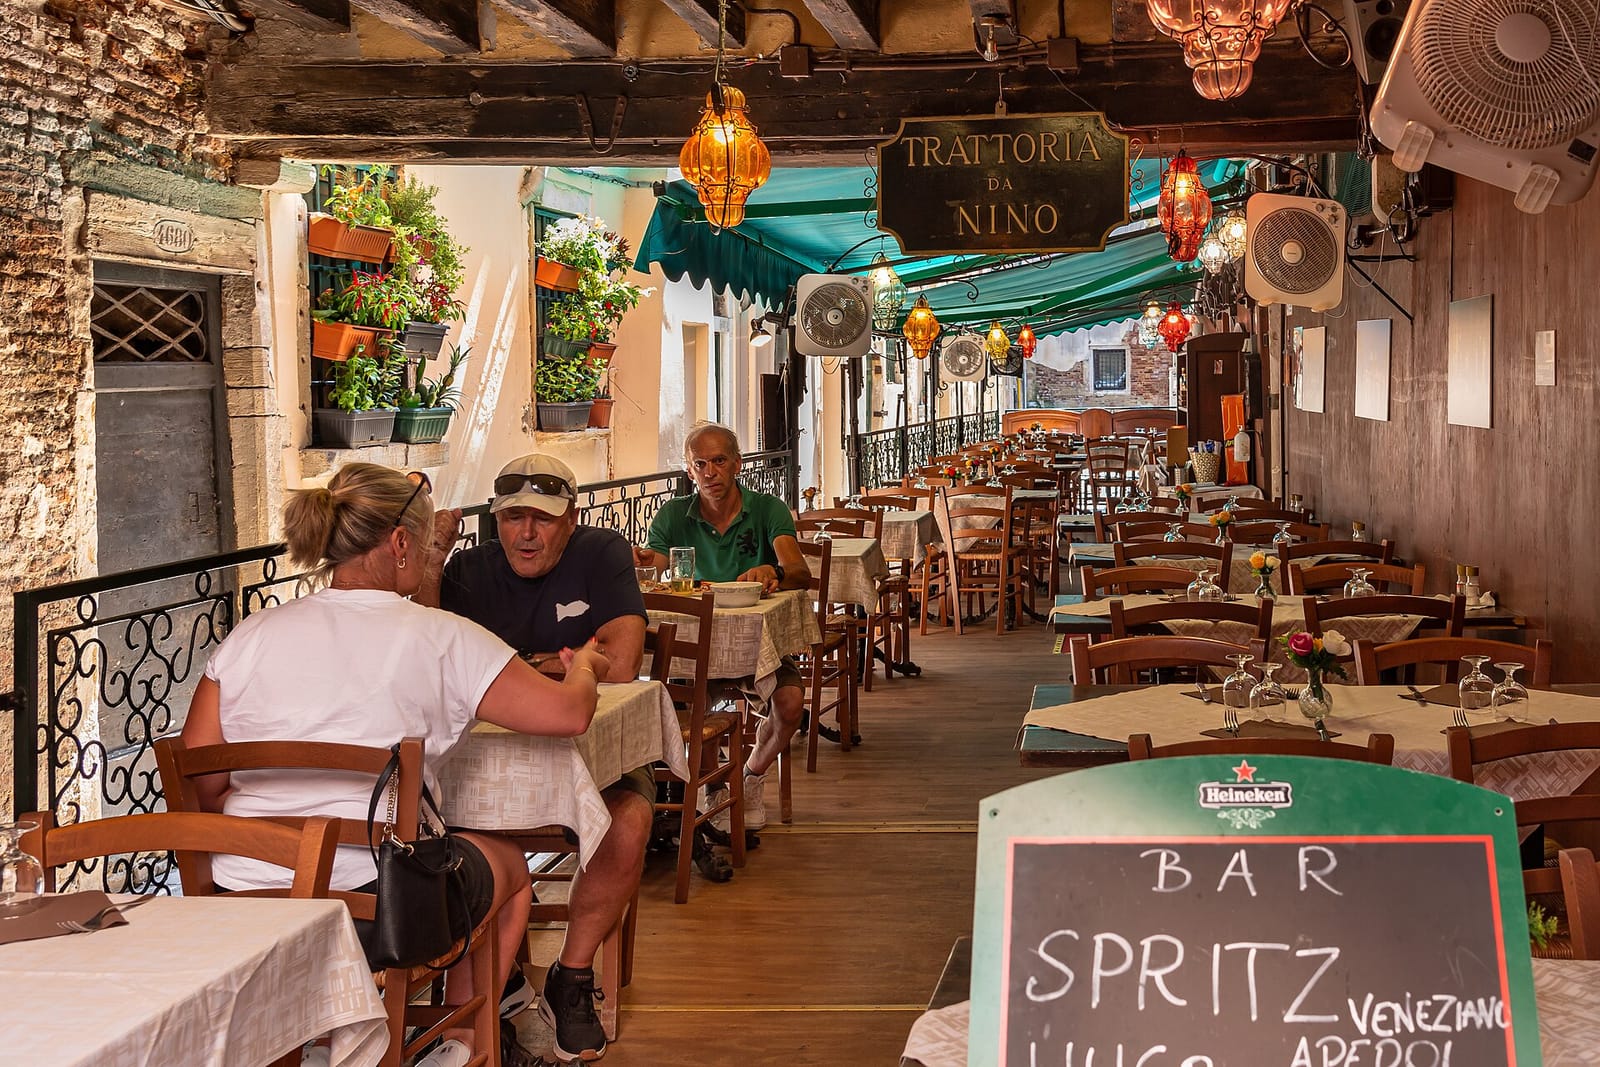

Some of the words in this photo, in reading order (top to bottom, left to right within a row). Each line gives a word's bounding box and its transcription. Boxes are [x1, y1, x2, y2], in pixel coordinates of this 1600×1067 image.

[900, 131, 1101, 167] TRATTORIA
[988, 177, 1013, 191] DA
[958, 203, 1058, 235] NINO
[1206, 787, 1286, 803] Heineken
[1140, 846, 1343, 896] BAR
[1025, 929, 1340, 1022] SPRITZ
